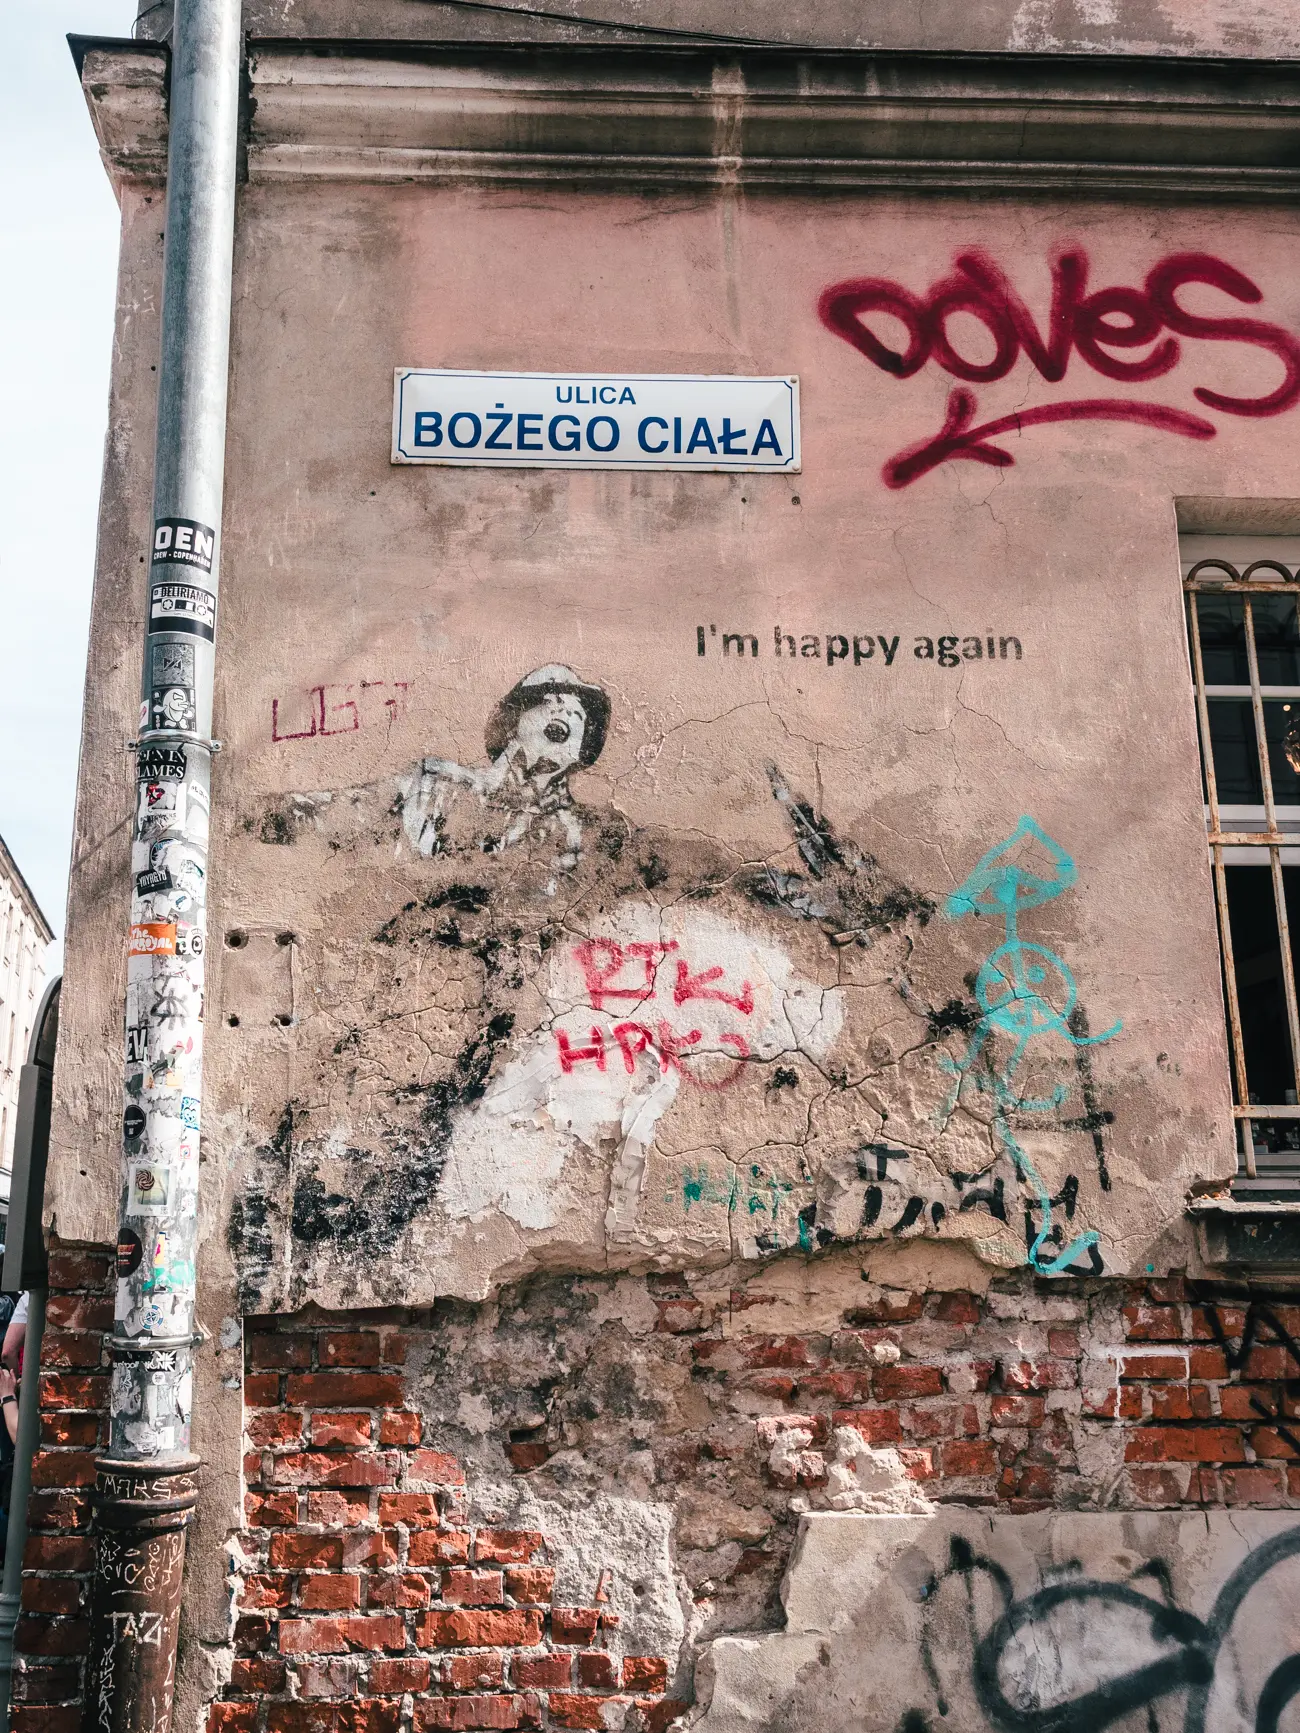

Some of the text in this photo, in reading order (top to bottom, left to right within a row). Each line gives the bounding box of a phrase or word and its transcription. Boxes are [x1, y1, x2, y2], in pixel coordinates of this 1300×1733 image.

[556, 385, 637, 405] ULICA
[413, 402, 783, 456] BOŻEGO CIAŁA
[161, 586, 209, 605] DELIRIAMO
[696, 623, 1023, 668] I'm happy again
